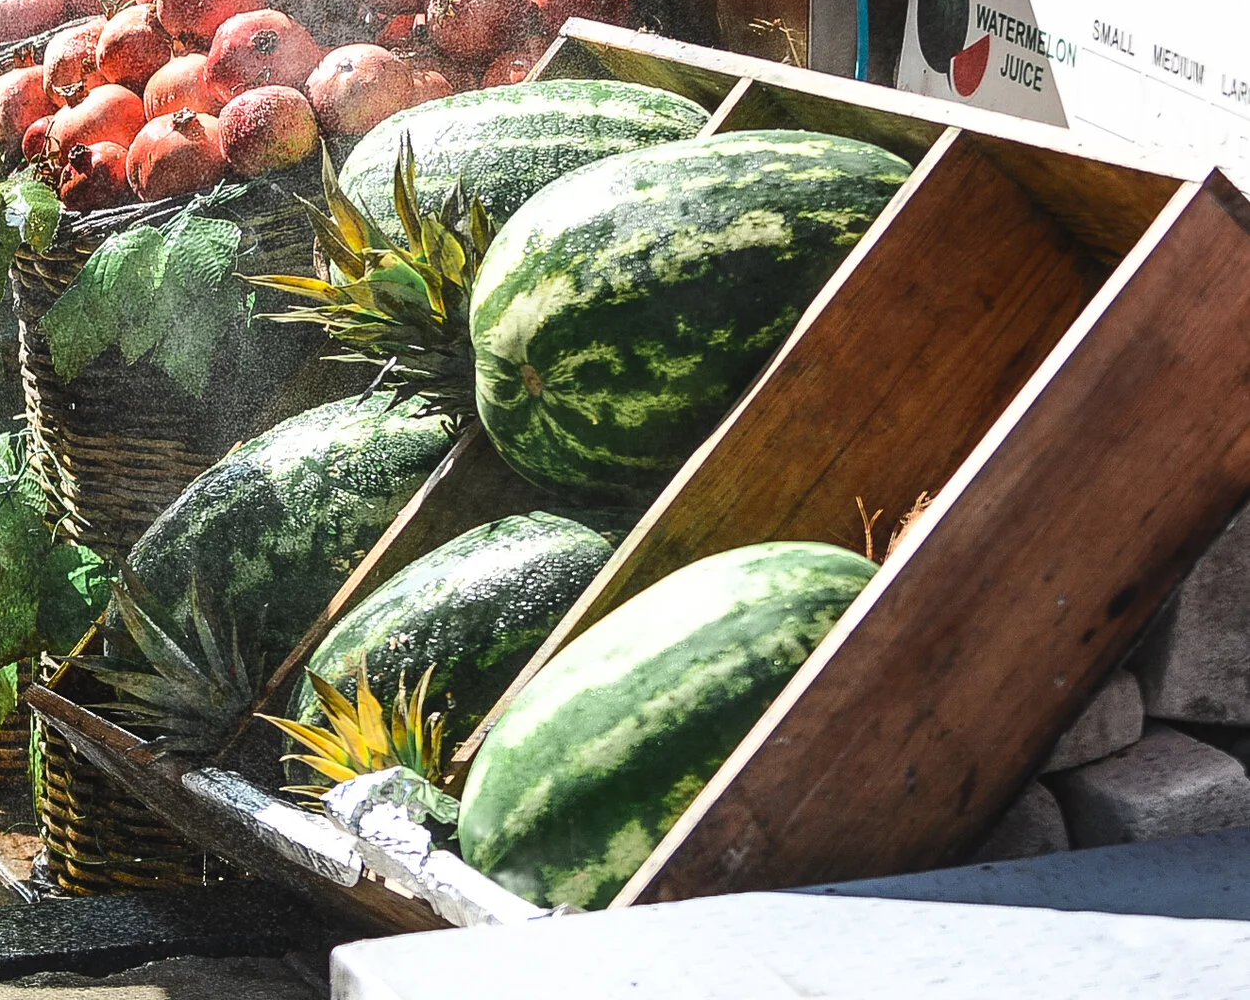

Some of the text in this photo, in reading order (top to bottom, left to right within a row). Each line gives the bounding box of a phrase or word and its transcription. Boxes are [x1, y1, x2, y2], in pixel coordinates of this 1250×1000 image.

[976, 3, 1078, 68] WATERMELON
[1092, 19, 1250, 107] SMALL MEDIUM LAR
[999, 53, 1044, 92] JUICE
